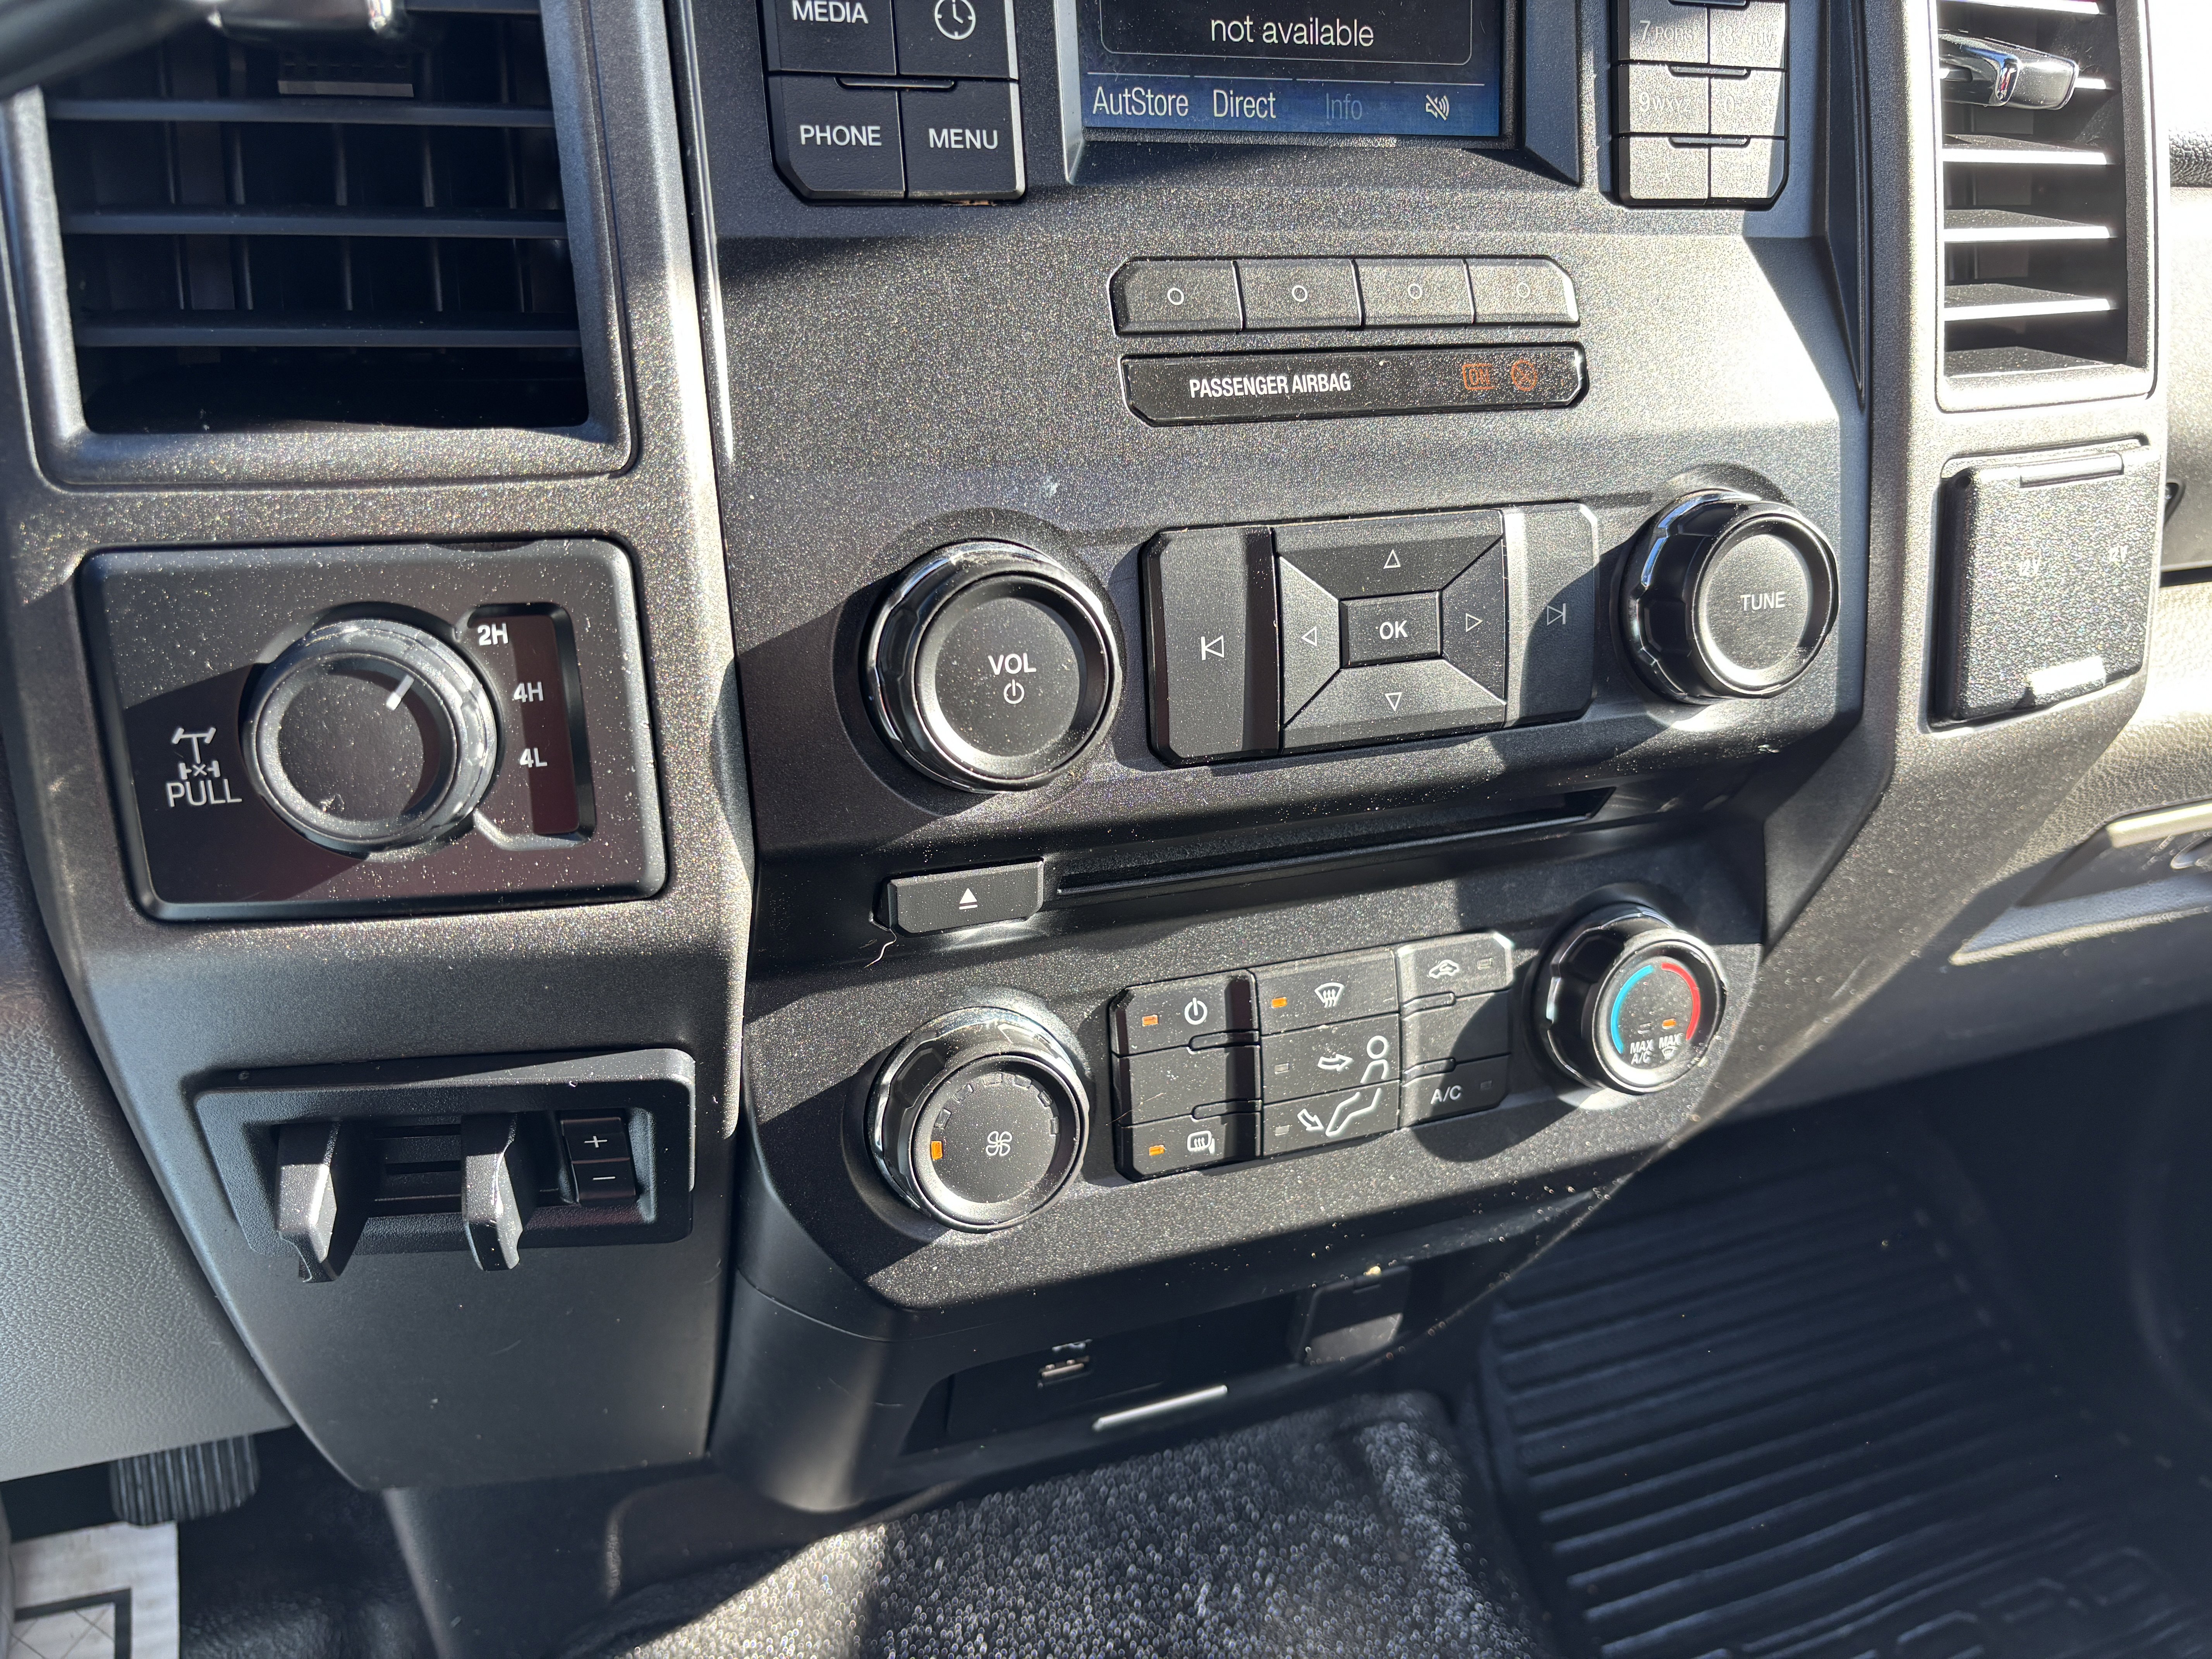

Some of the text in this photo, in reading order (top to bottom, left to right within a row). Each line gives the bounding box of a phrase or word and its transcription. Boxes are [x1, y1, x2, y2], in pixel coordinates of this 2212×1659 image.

[792, 0, 869, 24] MEDIA
[1211, 15, 1374, 47] not available
[1640, 20, 1651, 43] 7
[1092, 86, 1363, 120] AutStore Direct Info
[800, 125, 882, 146] PHONE
[929, 129, 998, 149] MENU
[1189, 373, 1351, 398] PASSENGER AIRBAG
[1469, 368, 1490, 386] ON
[1740, 592, 1785, 611] TUNE
[478, 623, 508, 646] 2H
[1379, 621, 1408, 640] OK
[988, 653, 1037, 675] VOL
[514, 681, 544, 703] 4H
[520, 747, 548, 768] 4L
[167, 778, 242, 807] PULL
[1630, 1039, 1654, 1054] MAX
[1659, 1034, 1682, 1049] MAX
[1631, 1051, 1652, 1065] A/C
[1431, 1085, 1462, 1104] A/C
